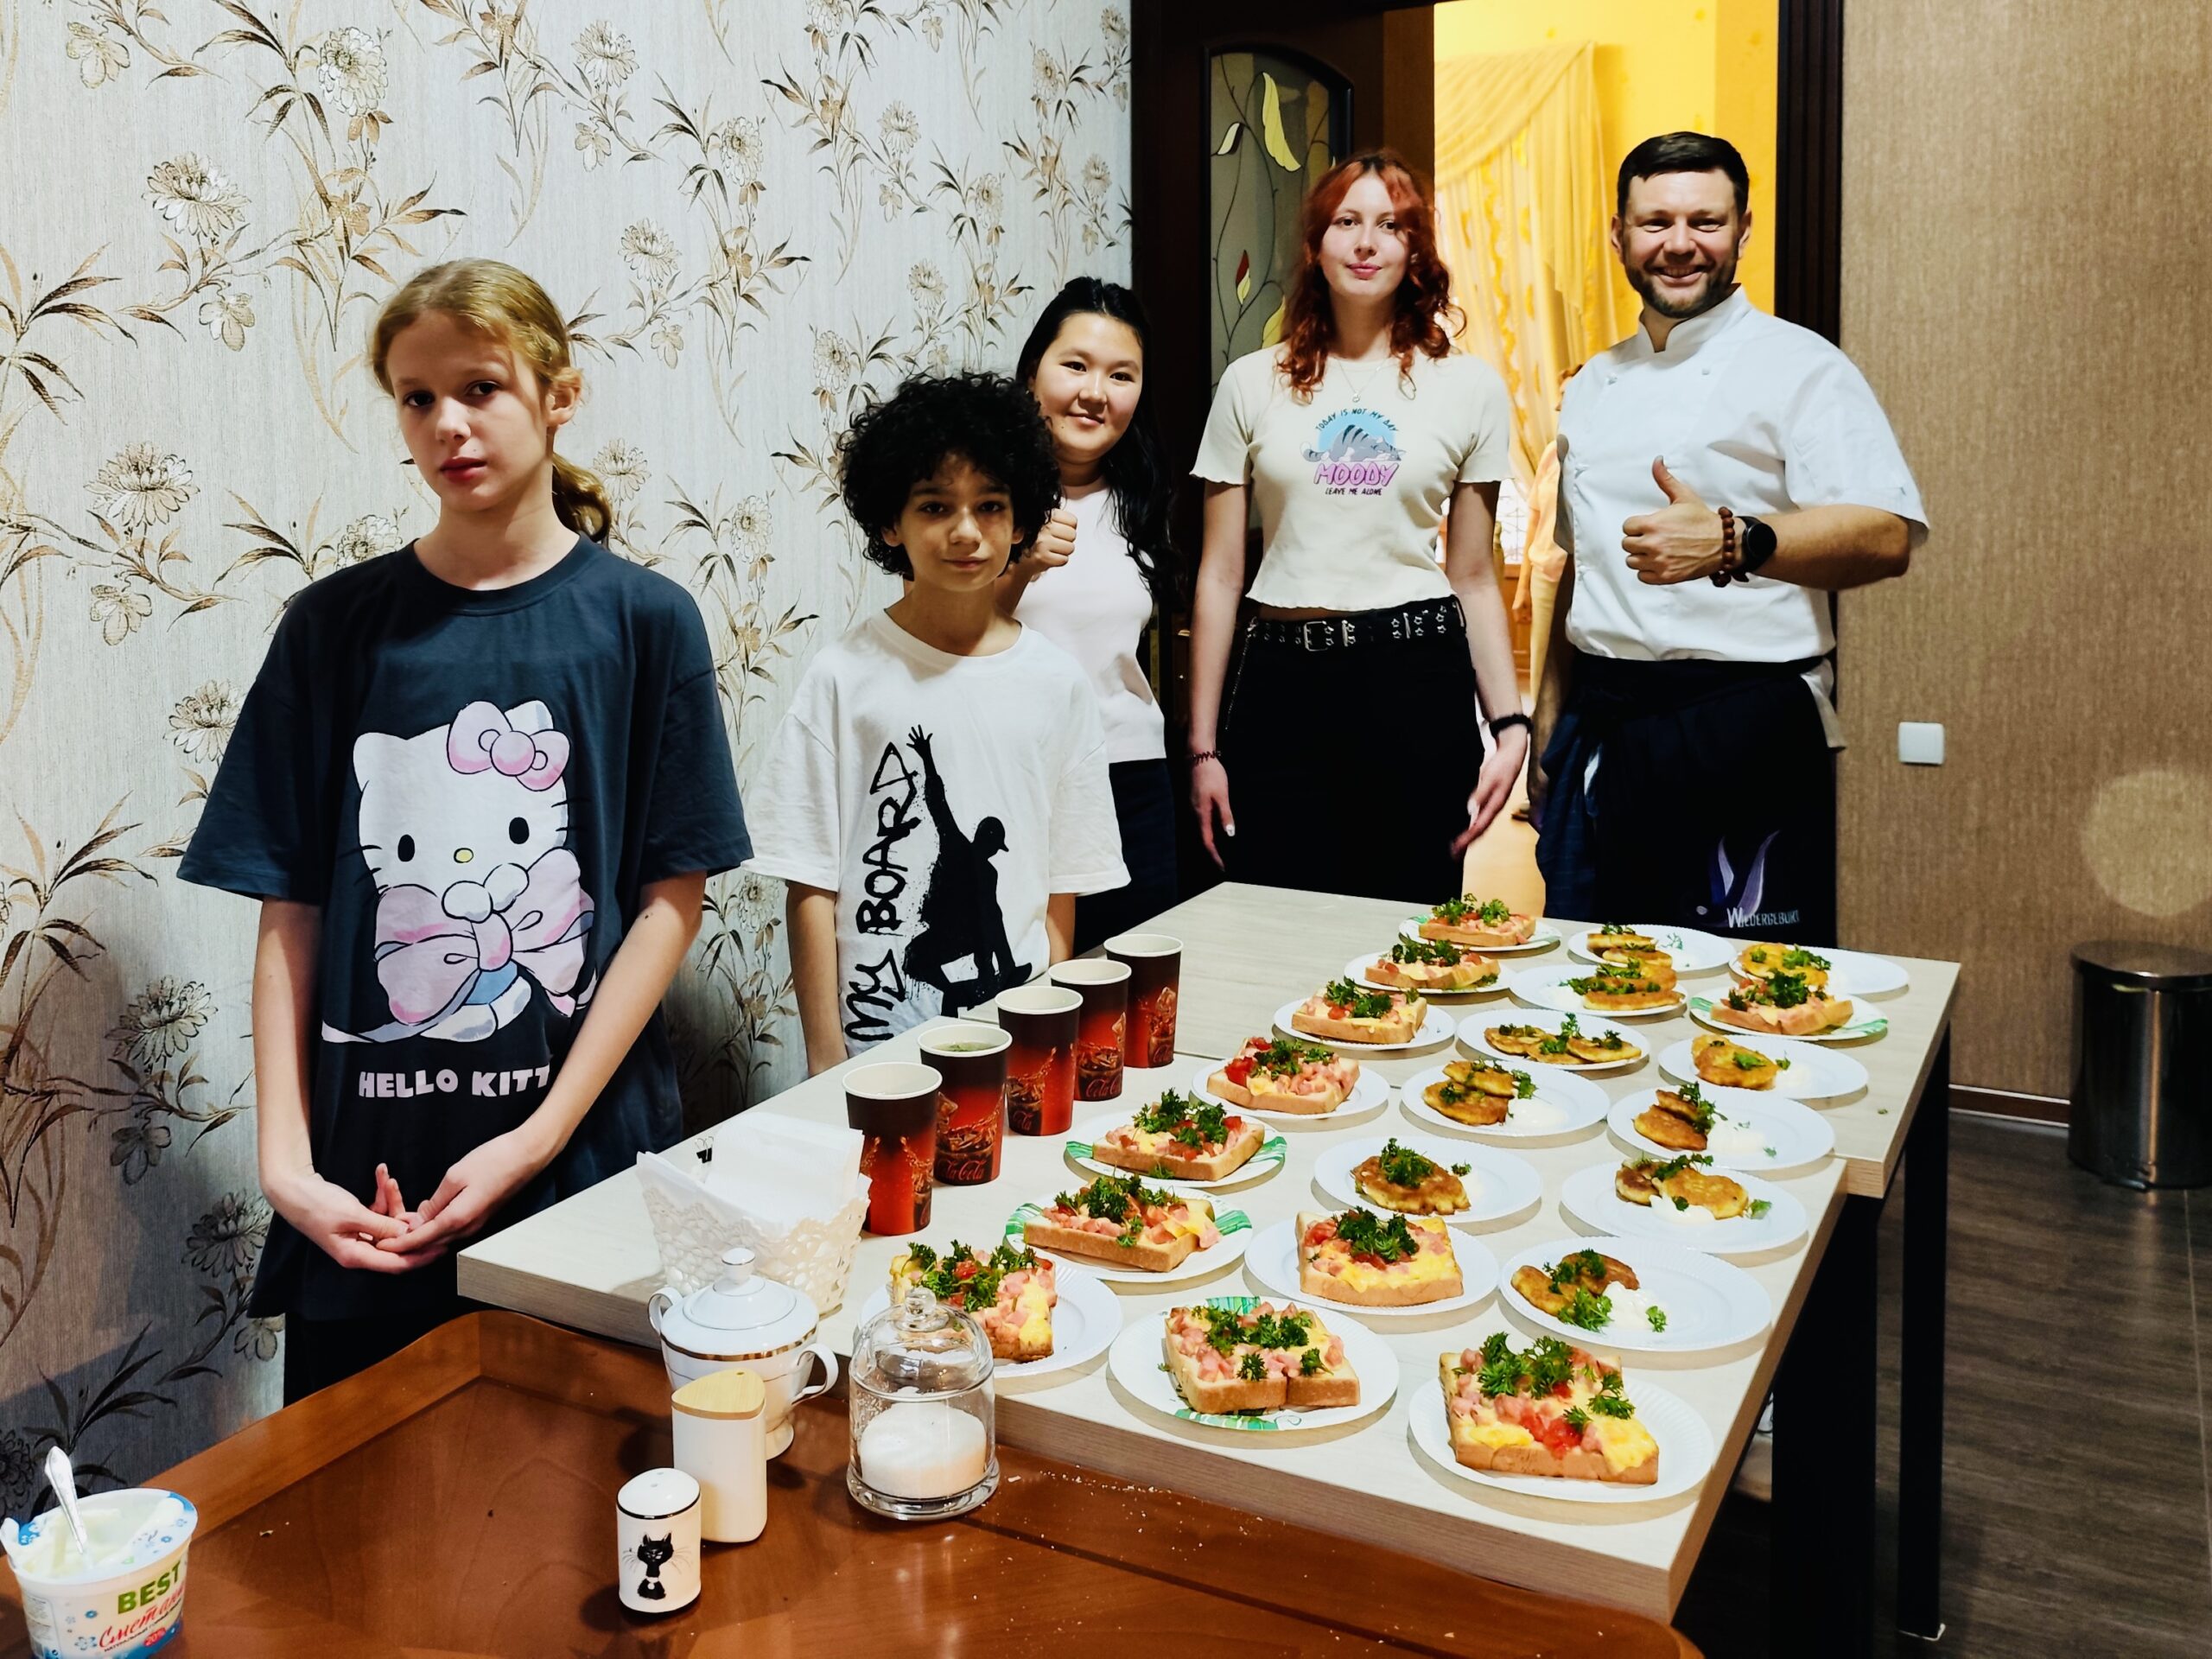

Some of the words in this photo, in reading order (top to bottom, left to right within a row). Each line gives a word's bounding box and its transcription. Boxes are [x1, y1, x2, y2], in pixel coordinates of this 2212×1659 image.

[1315, 412, 1337, 431] TODAY
[1370, 410, 1383, 420] MY
[1382, 419, 1399, 432] DAY
[1314, 461, 1400, 487] MOODY
[1325, 487, 1345, 496] LEAVE
[1361, 487, 1382, 496] ALONE
[855, 741, 922, 938] BOARD
[359, 1068, 459, 1098] HELLO
[472, 1062, 551, 1098] KITT
[118, 1560, 181, 1615] BEST
